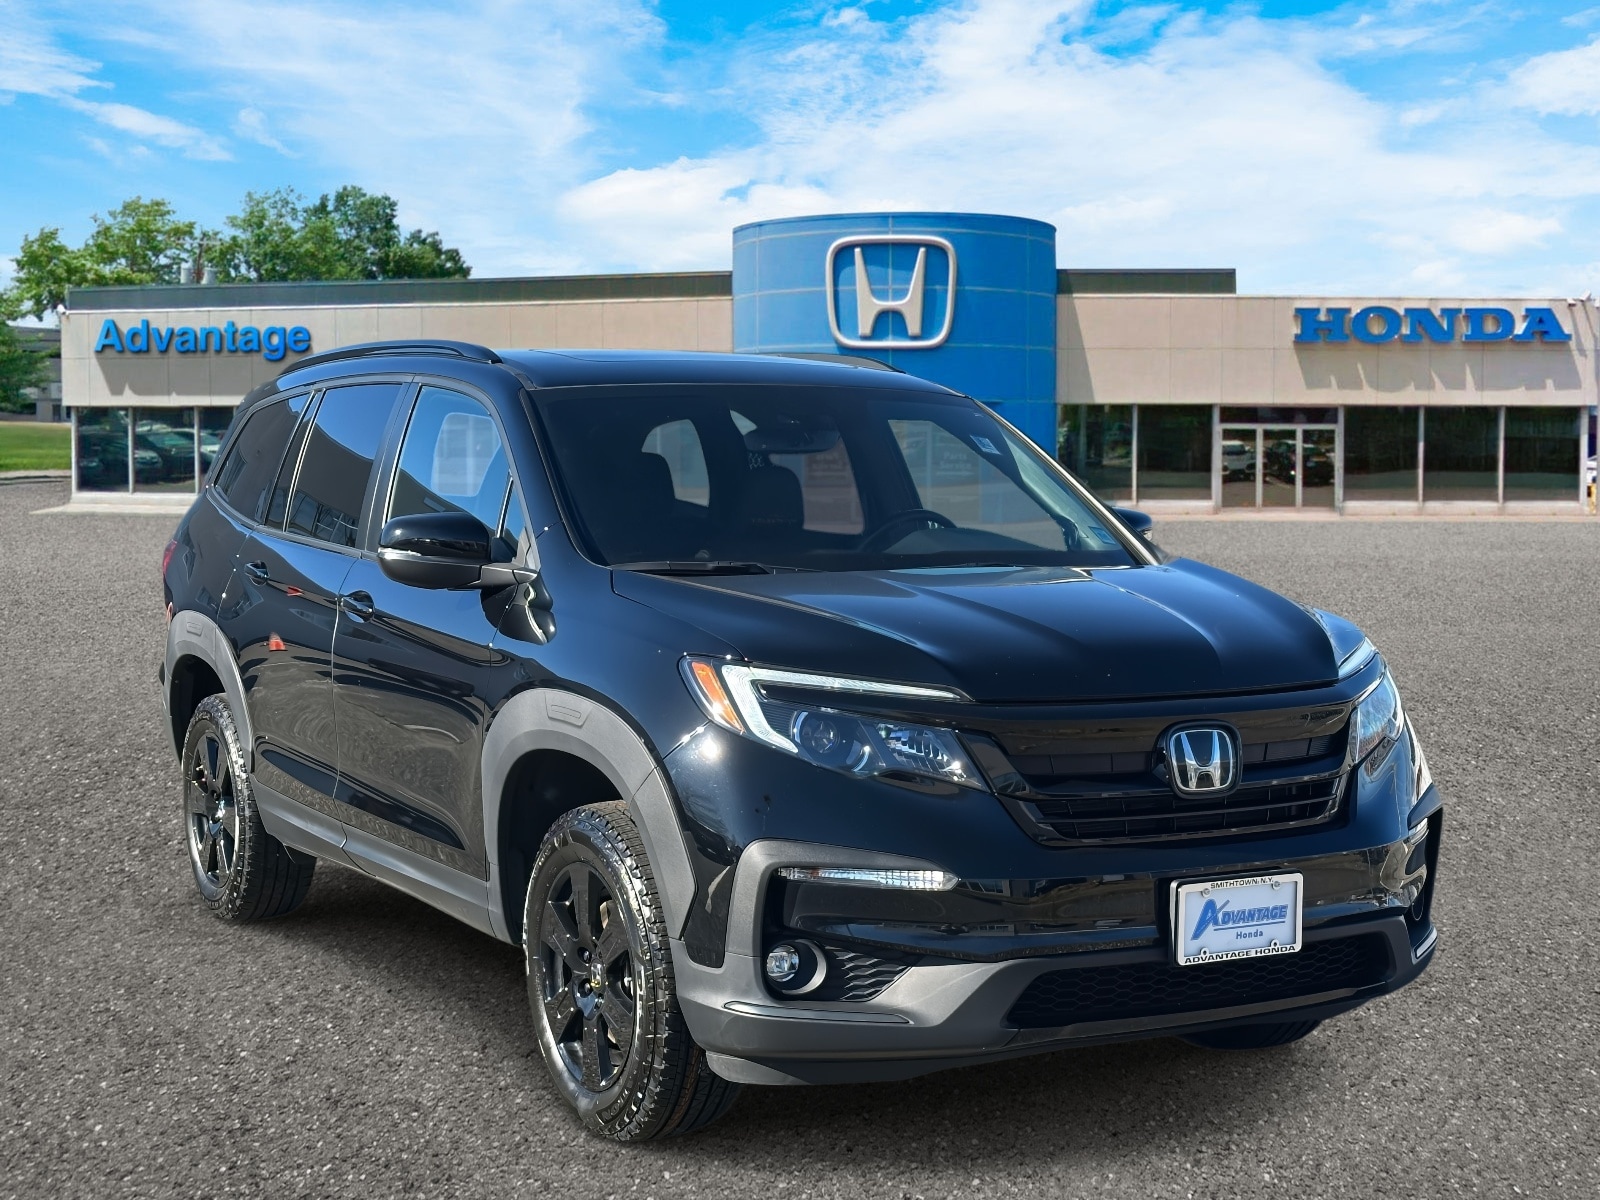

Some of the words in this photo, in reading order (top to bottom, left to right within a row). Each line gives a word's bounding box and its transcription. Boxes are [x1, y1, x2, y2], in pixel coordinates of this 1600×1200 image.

[95, 319, 311, 361] Advantage
[1294, 306, 1572, 343] HONDA
[1191, 898, 1288, 940] ADVANTAGE
[1235, 929, 1264, 940] Honda
[1184, 951, 1252, 964] ADVANTAGE
[1255, 945, 1296, 956] HONDA
